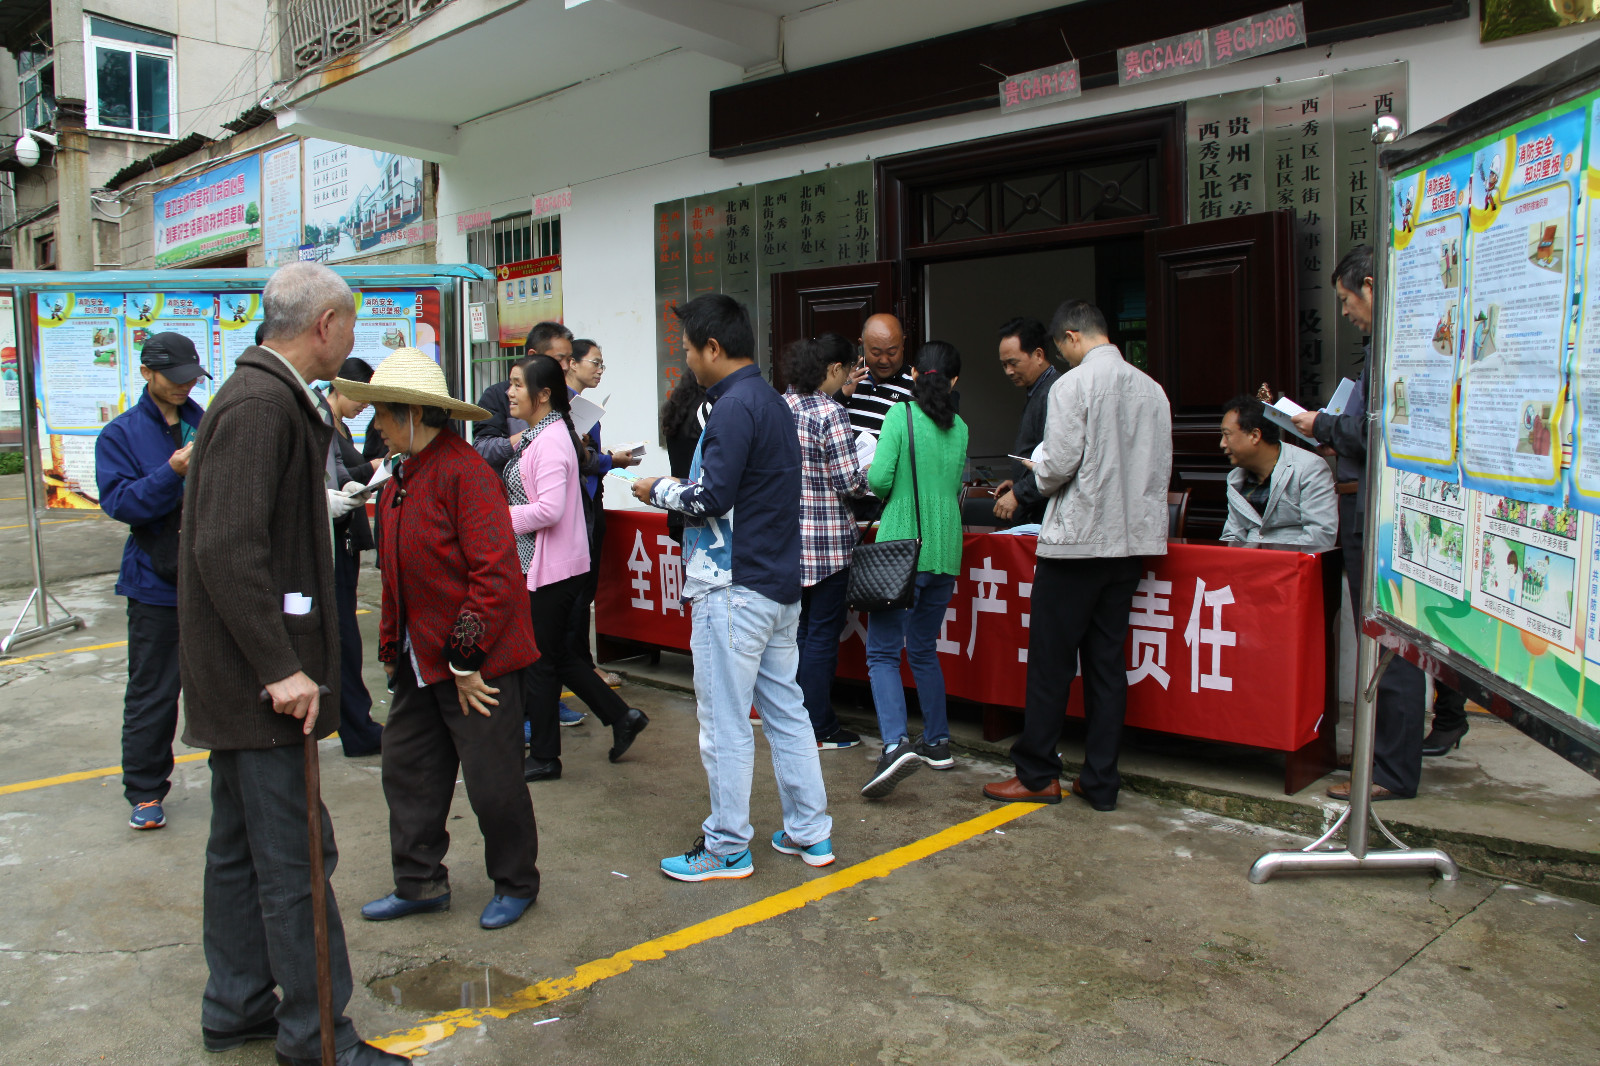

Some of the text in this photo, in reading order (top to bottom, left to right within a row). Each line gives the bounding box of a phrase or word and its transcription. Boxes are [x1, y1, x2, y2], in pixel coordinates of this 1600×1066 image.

[1123, 39, 1203, 81] 贵GCA420
[1214, 13, 1297, 60] 贵GJ7306
[1003, 69, 1078, 107] 贵GAR123
[1198, 120, 1223, 220] 西秀区北街
[1275, 106, 1295, 211] 一一二社区家
[1347, 103, 1369, 249] 一一二社区居
[1518, 135, 1555, 164] 消防安全
[1524, 153, 1561, 184] 知识壁报
[1427, 172, 1452, 196] 消防安全
[1432, 189, 1457, 213] 知识壁报
[660, 213, 670, 263] 北街办事处
[692, 207, 703, 265] 北街办事处
[726, 200, 738, 265] 北街办事处
[739, 199, 750, 264] 西秀区
[763, 195, 776, 256] 北街办事处
[776, 192, 788, 253] 西秀区
[800, 186, 813, 254] 北街办事处
[814, 183, 827, 251] 西秀区
[837, 198, 851, 263] 一一二社
[855, 189, 870, 263] 北街办事
[364, 298, 394, 307] 消防安全
[371, 306, 402, 315] 知识壁报
